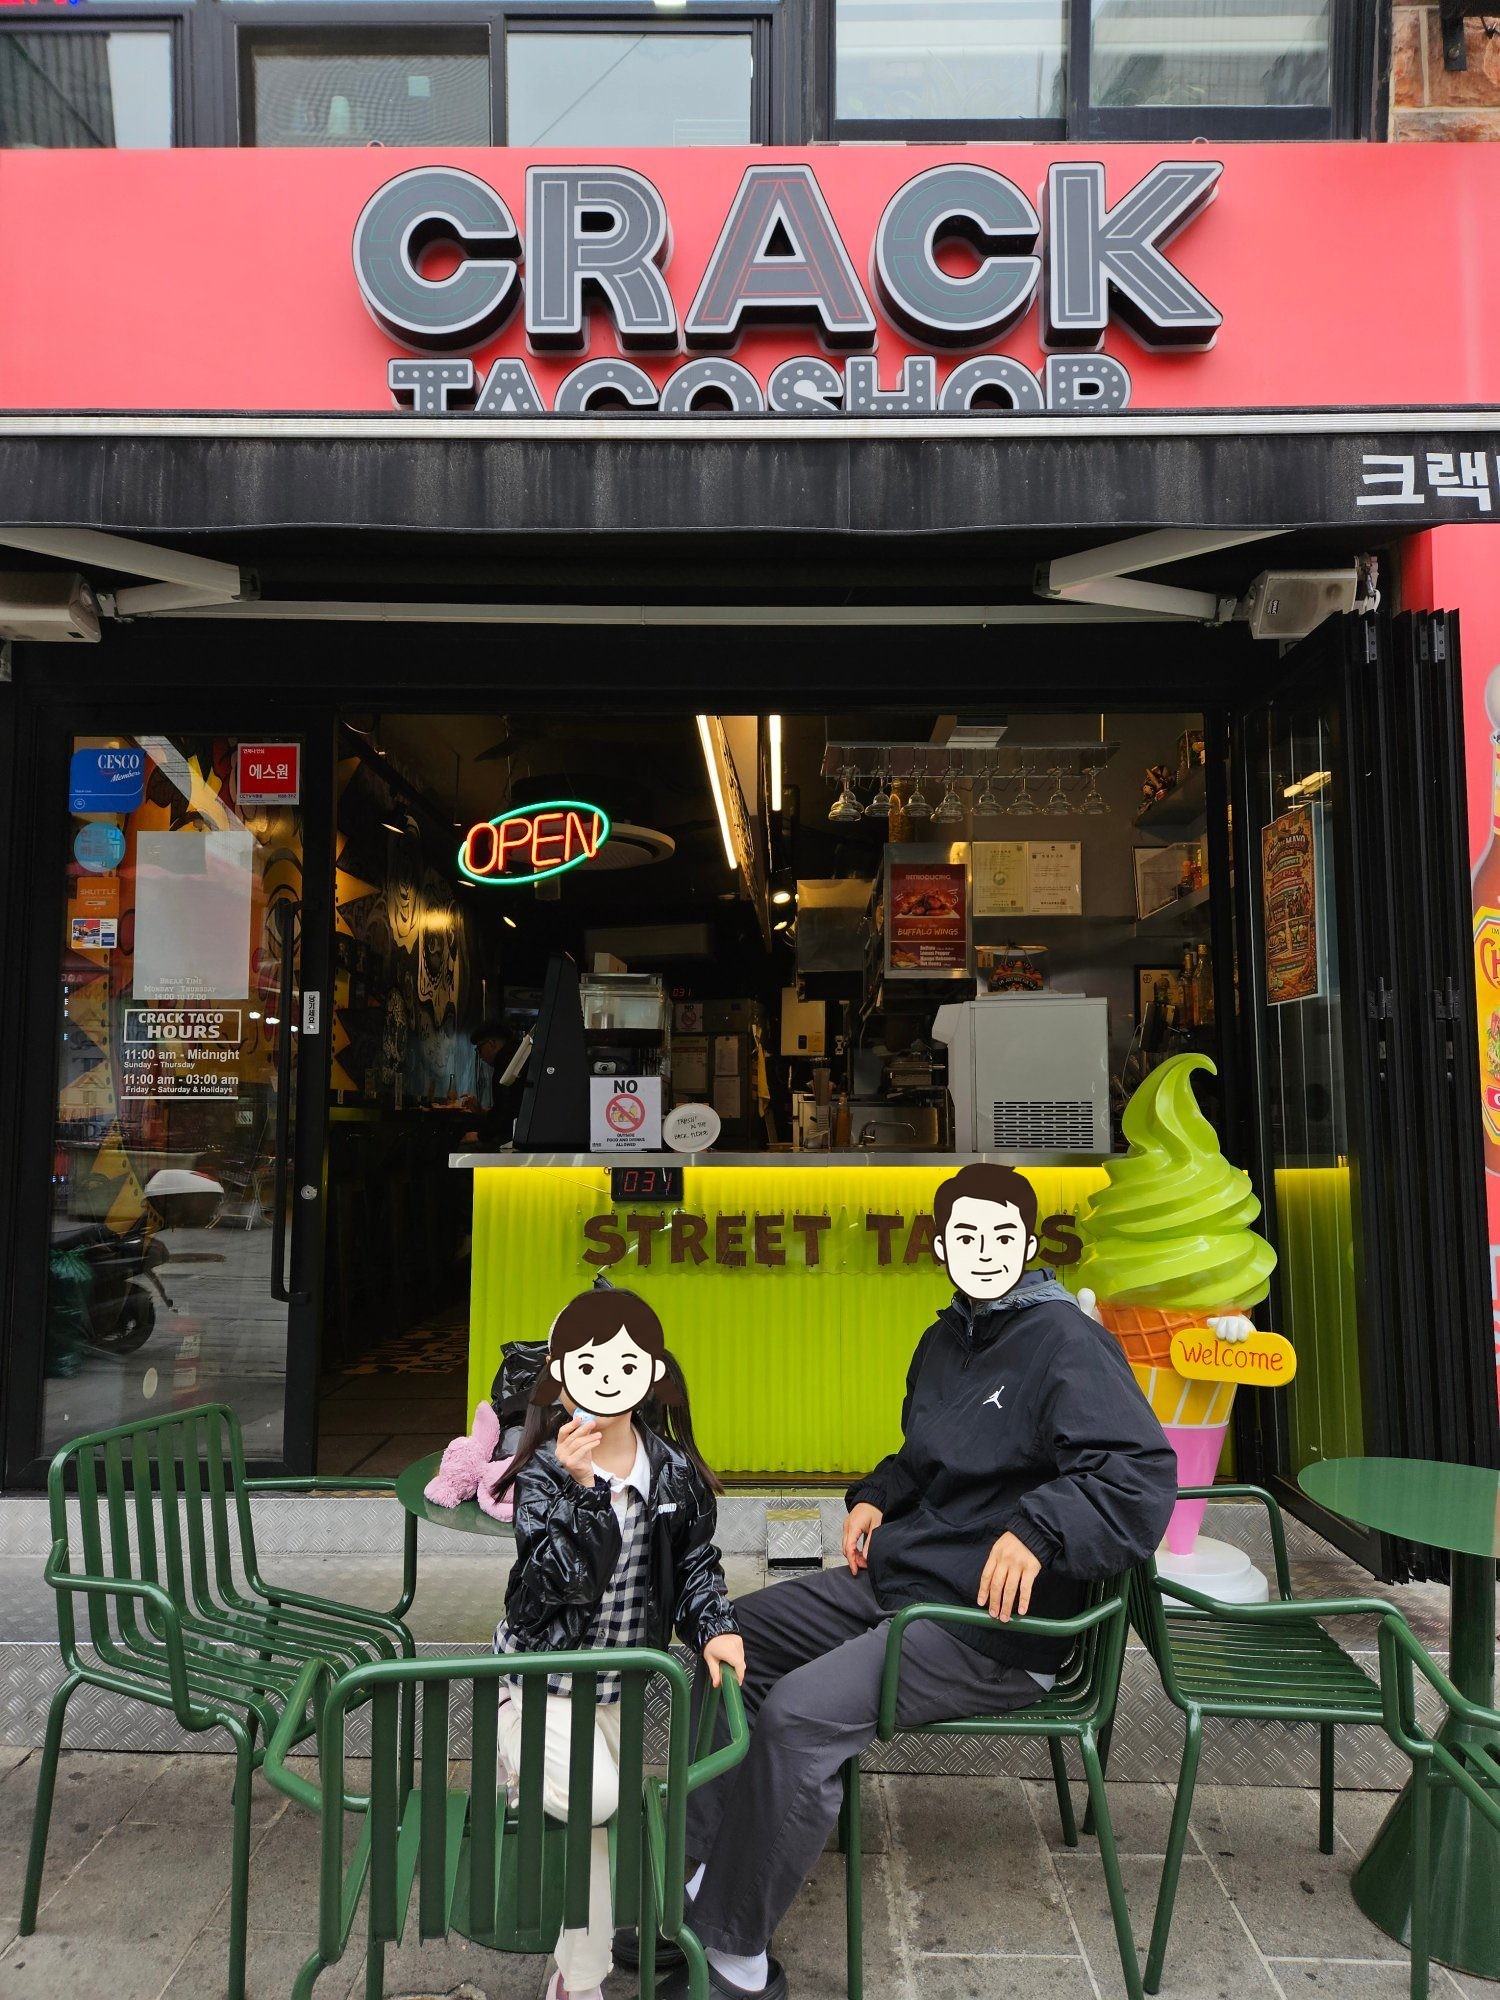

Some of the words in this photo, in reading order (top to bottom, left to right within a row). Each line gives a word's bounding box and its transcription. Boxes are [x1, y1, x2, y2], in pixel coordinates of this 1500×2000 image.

[353, 160, 1223, 346] CRACK
[1356, 451, 1500, 511] 크랙
[97, 754, 140, 769] CESCO
[110, 769, 141, 783] Members
[248, 763, 288, 780] 에스원
[464, 811, 600, 875] OPEN
[905, 873, 951, 881] INTRODUCING
[897, 927, 932, 936] BUFFALO
[933, 927, 959, 936] WINGS
[138, 1012, 185, 1024] CRACK
[188, 1012, 224, 1024] TACO
[147, 1025, 221, 1039] HOURS
[125, 1049, 155, 1060] 11:00
[158, 1050, 176, 1060] am
[187, 1049, 240, 1062] Midnight
[123, 1061, 152, 1069] Sunday
[160, 1061, 195, 1069] Thursday
[123, 1074, 154, 1085] 11:00
[157, 1075, 175, 1085] am
[186, 1074, 218, 1085] 03:00
[221, 1075, 239, 1085] am
[613, 1079, 638, 1094] NO
[125, 1086, 149, 1094] Friday
[158, 1086, 191, 1094] Saturday
[200, 1086, 233, 1094] Holidays
[622, 1170, 673, 1194] 031
[581, 1213, 832, 1267] STREET
[866, 1213, 1084, 1266] TAS
[1178, 1339, 1284, 1371] Welcome
